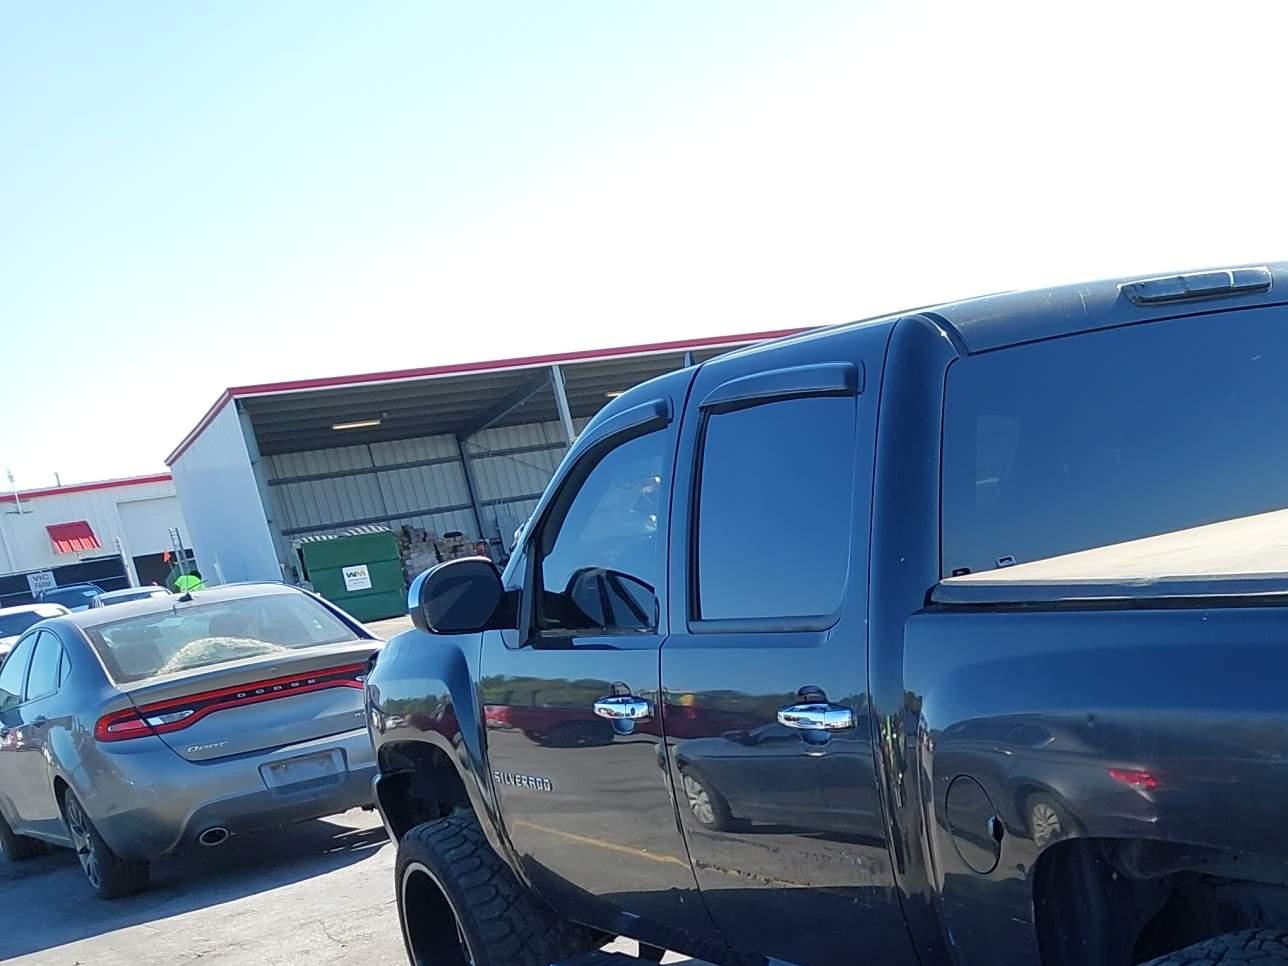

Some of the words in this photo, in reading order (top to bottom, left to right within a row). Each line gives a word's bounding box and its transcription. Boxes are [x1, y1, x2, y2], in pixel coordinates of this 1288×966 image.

[345, 570, 366, 578] WM
[236, 679, 317, 698] DODGE
[494, 771, 552, 792] SILVERADO
